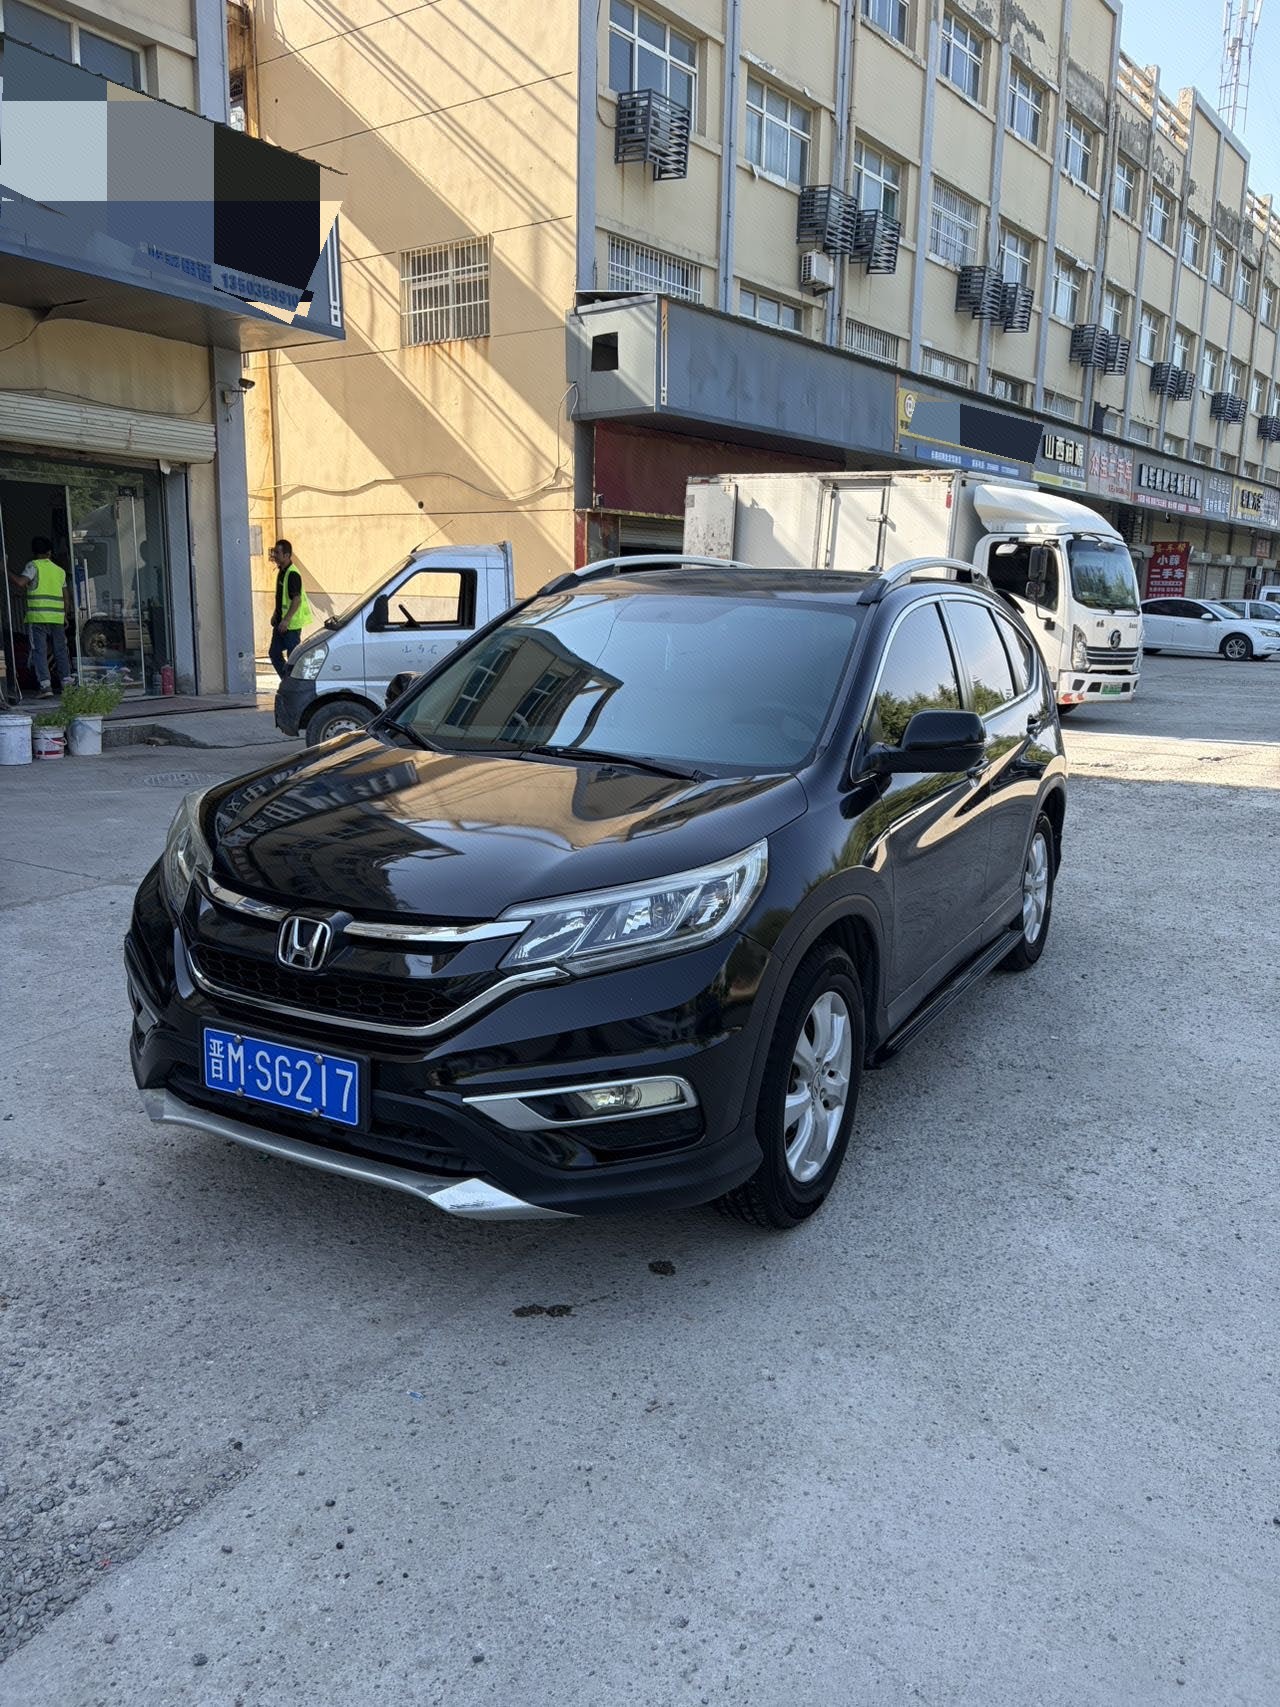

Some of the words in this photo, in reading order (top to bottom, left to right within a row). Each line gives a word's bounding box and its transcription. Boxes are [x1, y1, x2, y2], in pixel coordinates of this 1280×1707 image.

[1150, 568, 1185, 580] 二手车
[209, 1038, 353, 1113] 晋M·SG217
